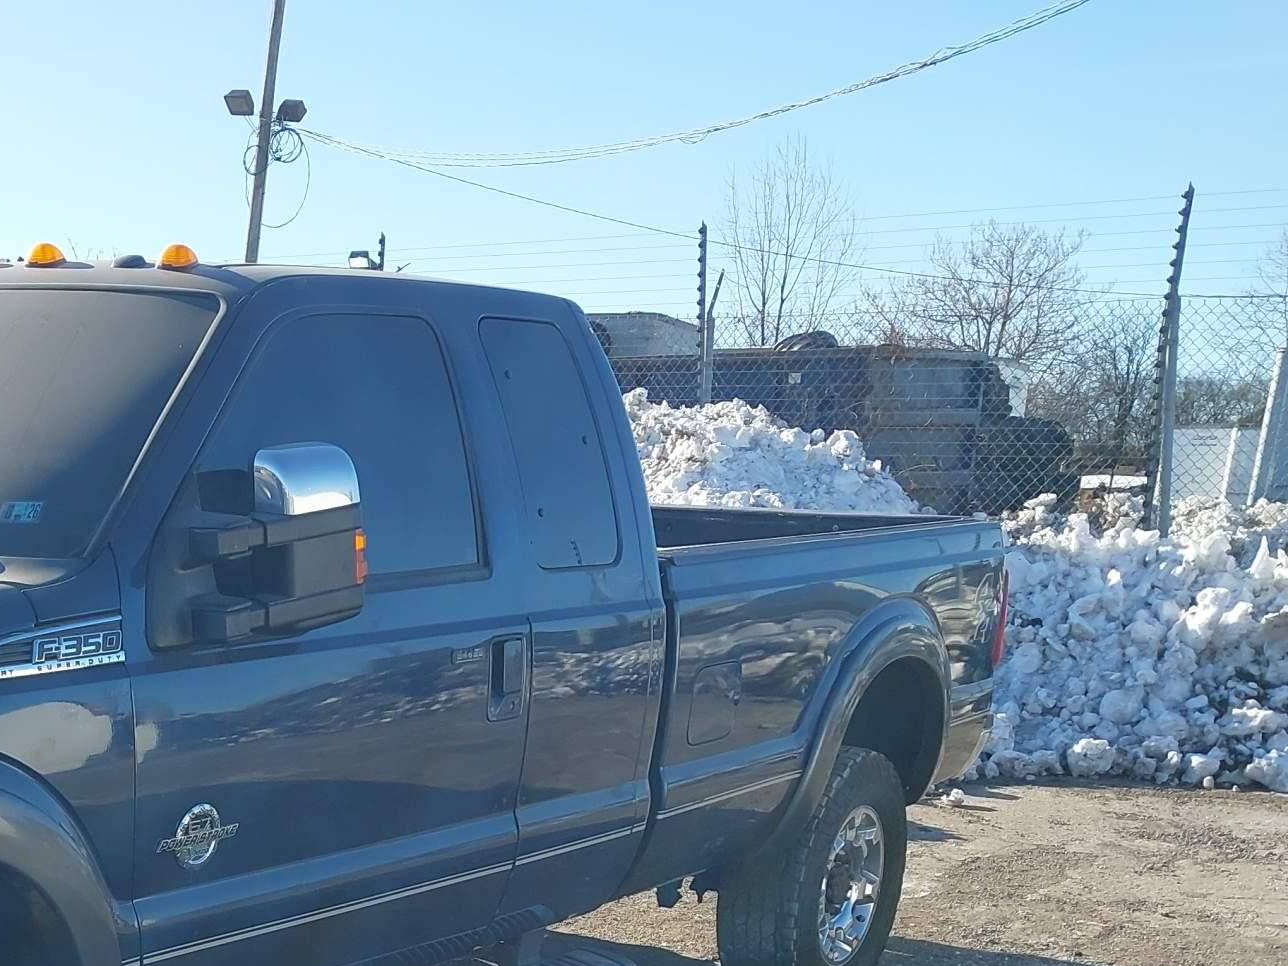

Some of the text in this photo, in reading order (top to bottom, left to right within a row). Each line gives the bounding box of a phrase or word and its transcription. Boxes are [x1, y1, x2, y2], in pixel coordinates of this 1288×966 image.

[36, 631, 123, 662] F-350
[36, 654, 123, 673] SUPER DUTY
